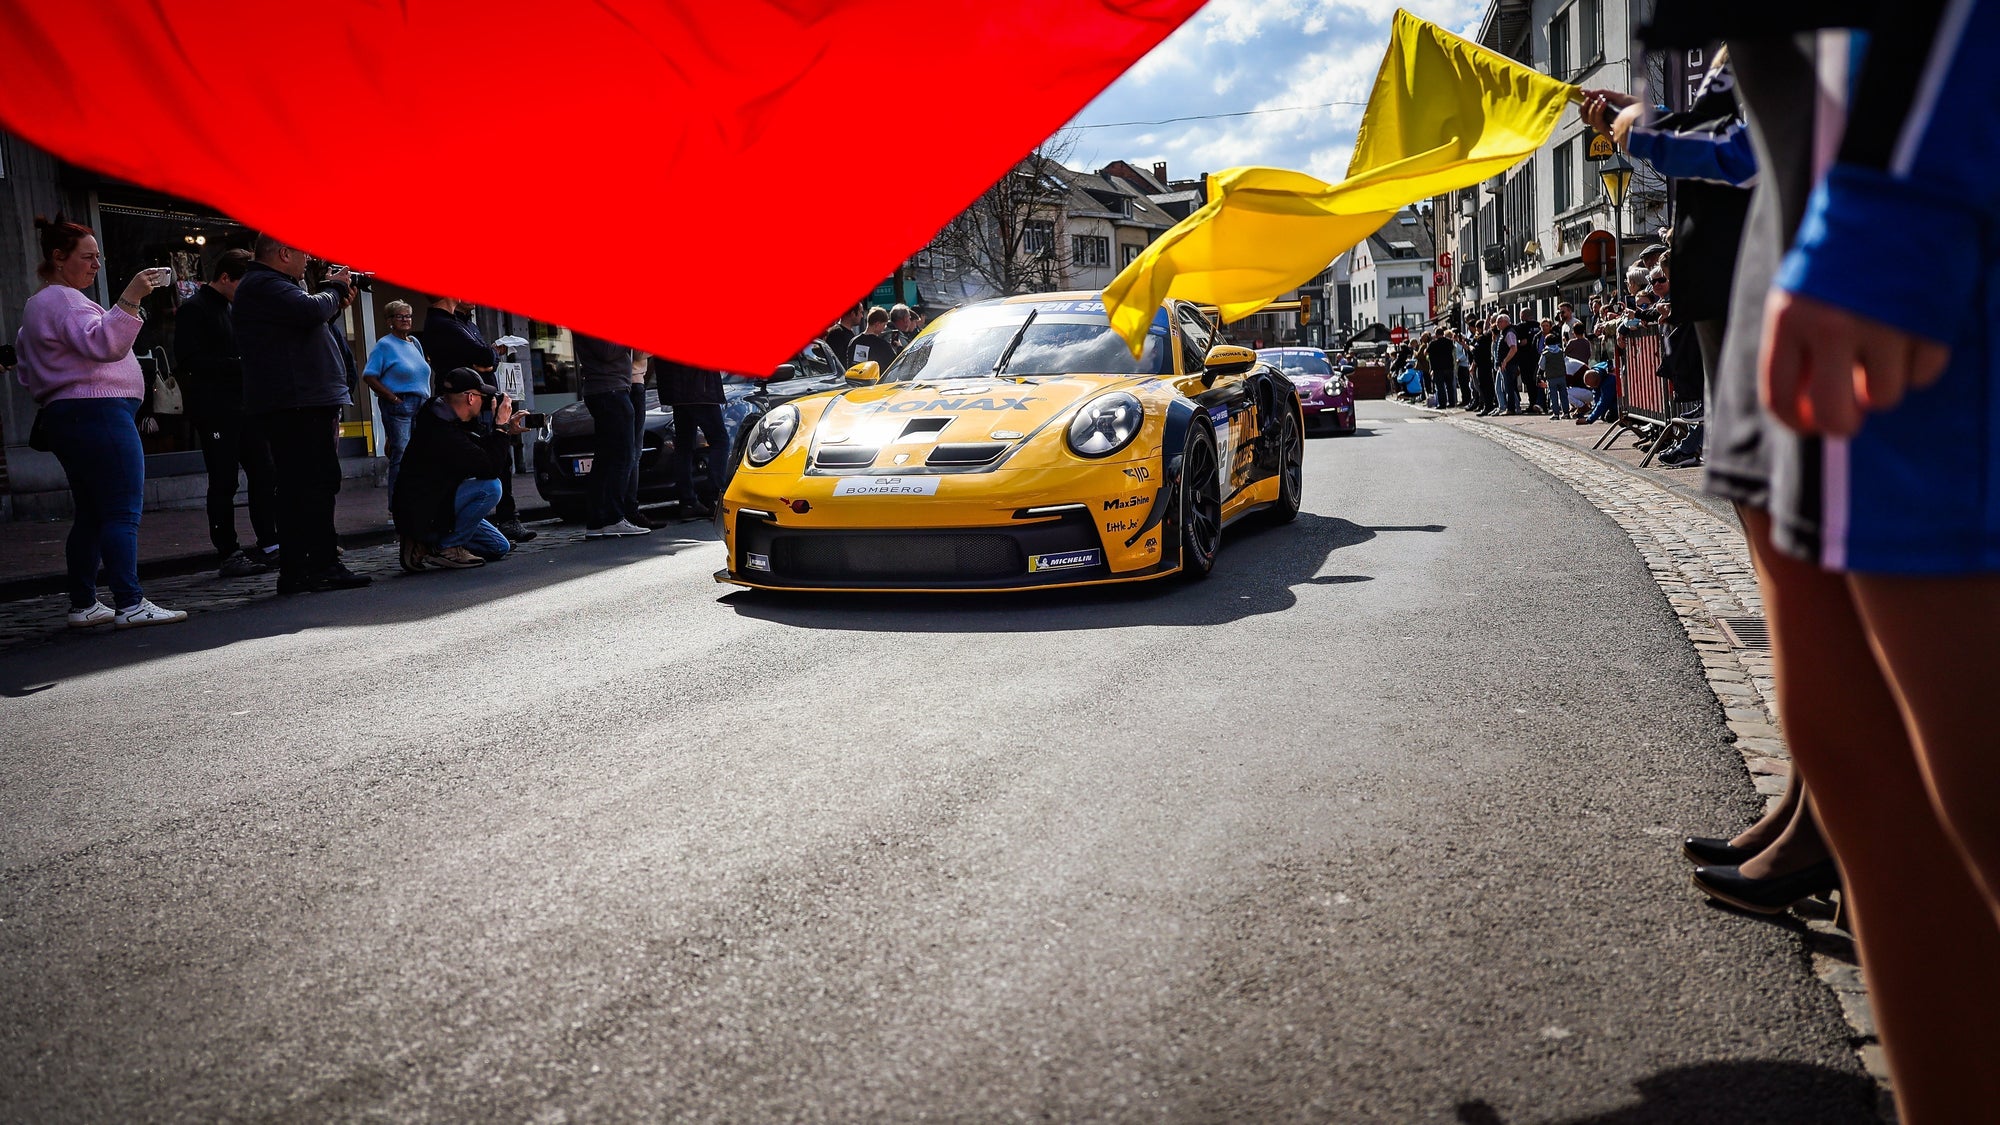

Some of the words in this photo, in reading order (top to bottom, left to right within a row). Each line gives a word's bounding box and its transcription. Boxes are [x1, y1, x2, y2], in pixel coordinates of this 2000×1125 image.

[1075, 302, 1107, 312] SP
[859, 397, 1037, 413] SONAX
[1103, 495, 1150, 511] MaxShine
[1106, 520, 1126, 533] Little
[1050, 555, 1092, 565] MICHELIN
